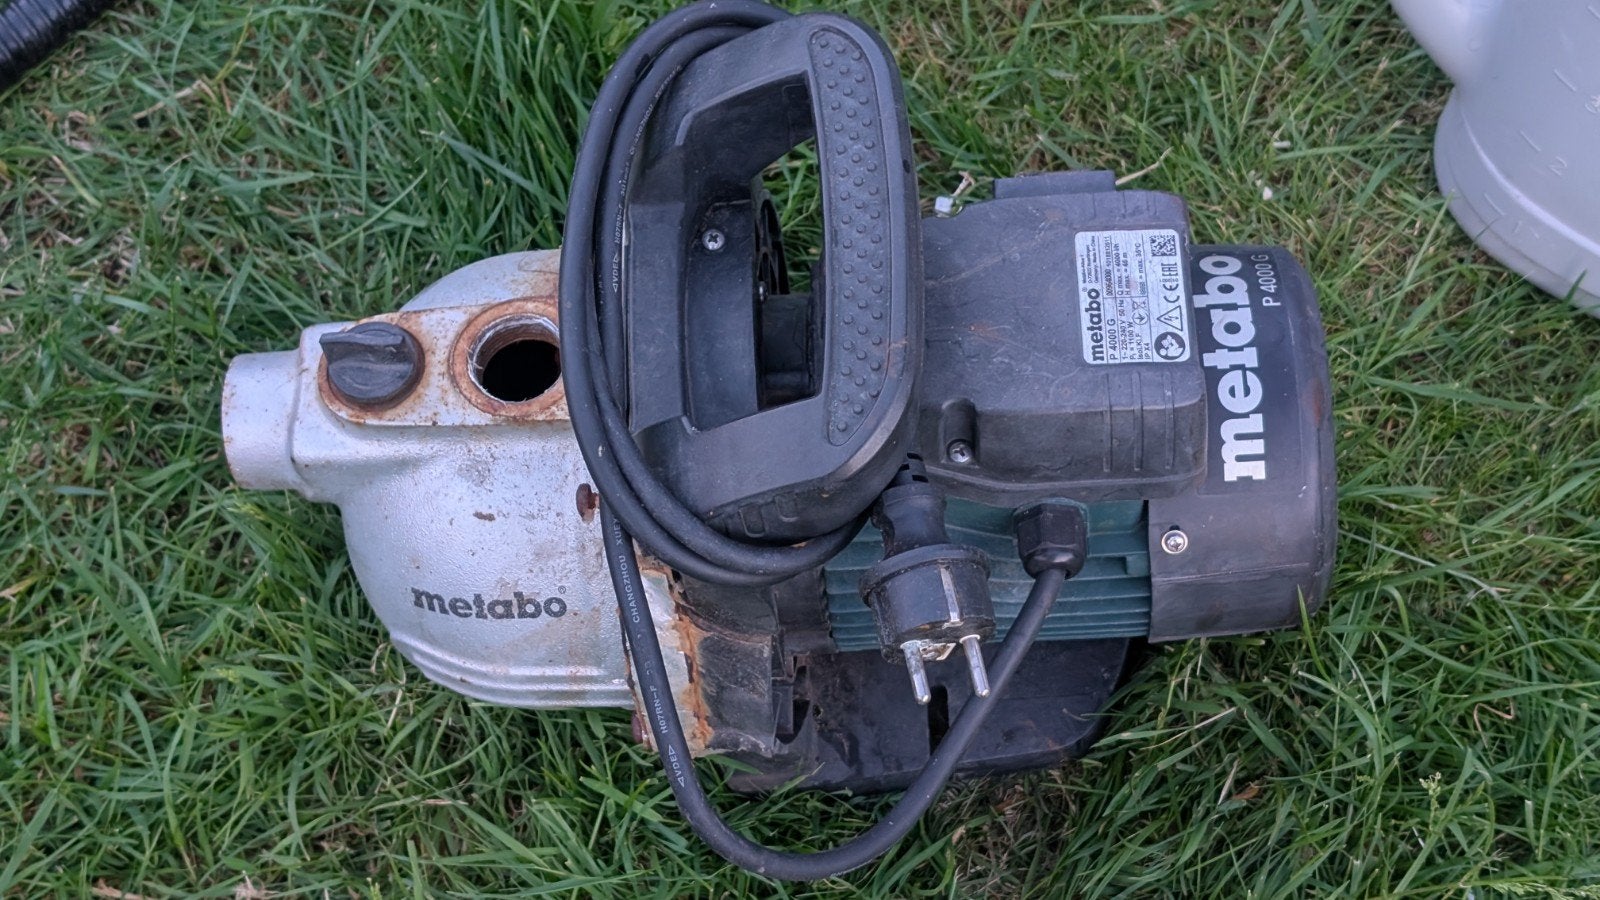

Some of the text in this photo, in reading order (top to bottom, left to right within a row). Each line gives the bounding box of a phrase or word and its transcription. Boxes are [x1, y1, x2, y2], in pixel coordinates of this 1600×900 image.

[1251, 254, 1281, 307] P 4000 G
[1085, 288, 1104, 362] metabo
[1107, 318, 1116, 326] G
[1108, 330, 1117, 351] 4000
[1142, 343, 1151, 360] IP X4
[1193, 254, 1266, 482] metabo
[411, 587, 568, 620] metabo
[619, 555, 641, 623] CHANGZHOU
[650, 685, 683, 778] VDE H07RN-F
